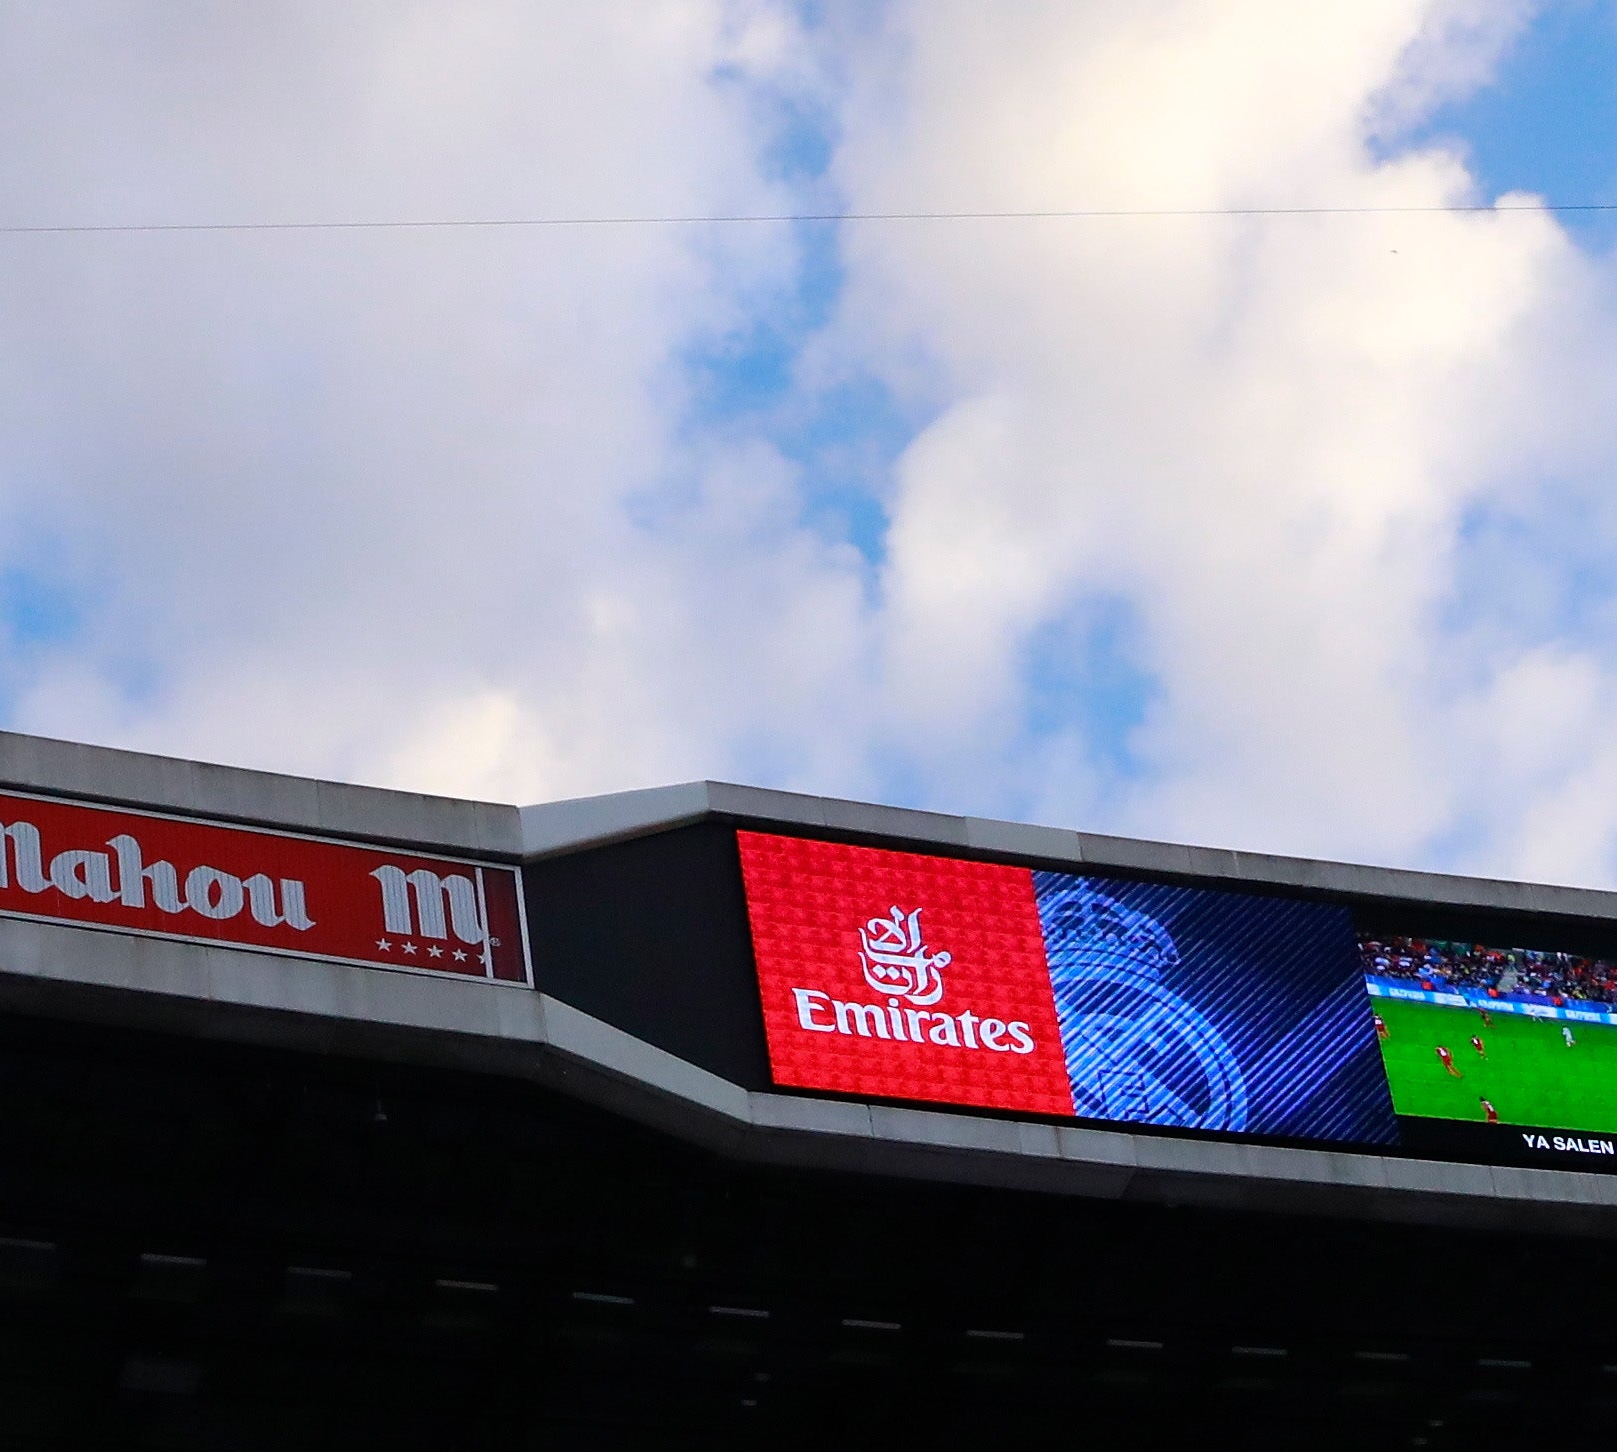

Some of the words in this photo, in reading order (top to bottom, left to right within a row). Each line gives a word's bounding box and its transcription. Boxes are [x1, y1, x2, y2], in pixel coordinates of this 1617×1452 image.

[791, 988, 1034, 1055] Emirates
[1522, 1133, 1550, 1150] YA
[1553, 1136, 1615, 1155] SALEN
